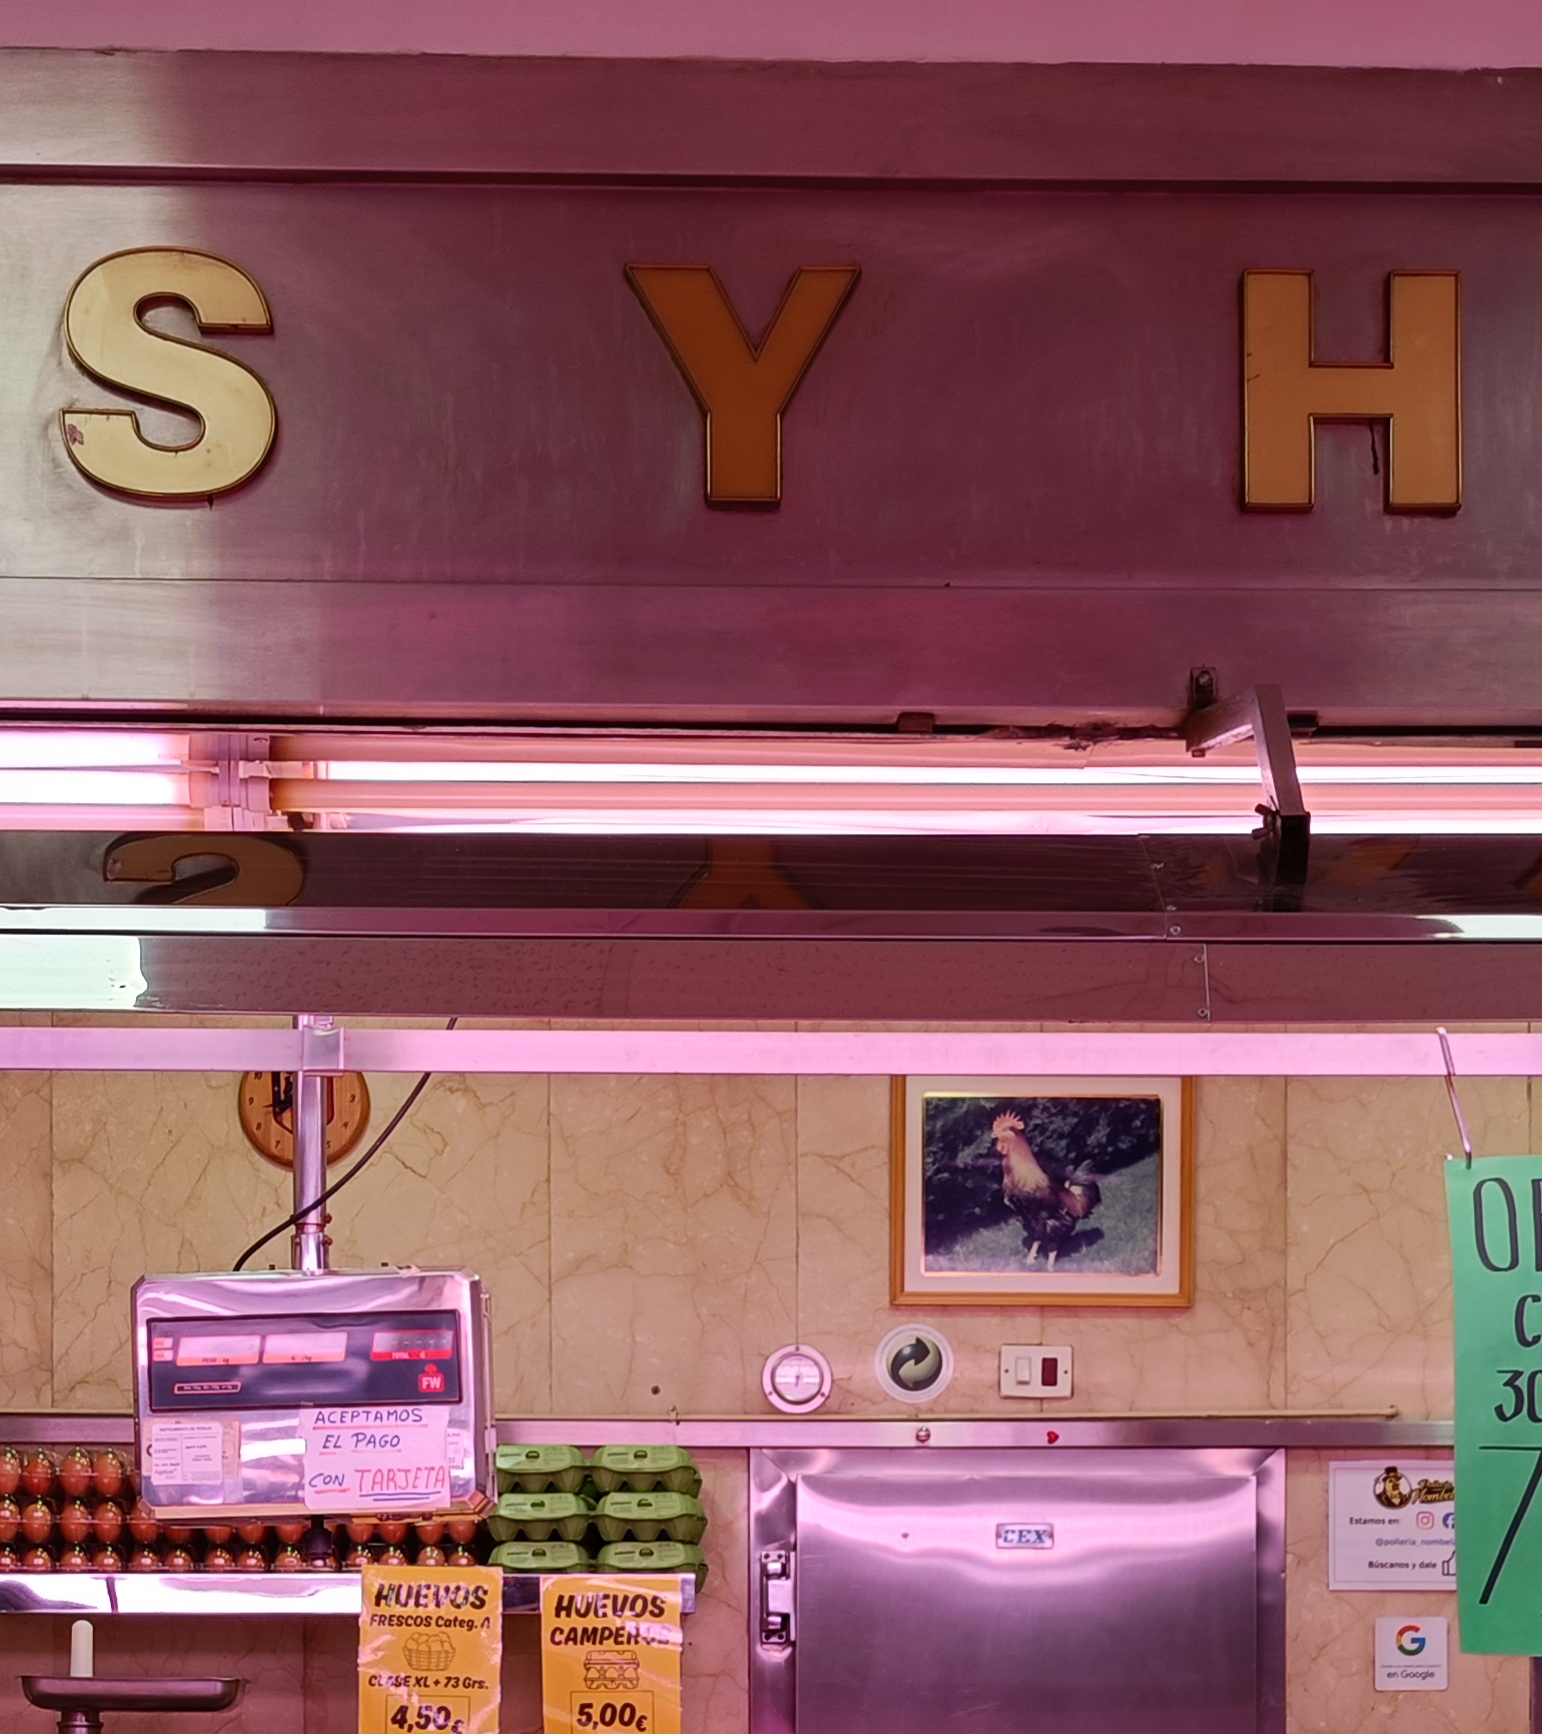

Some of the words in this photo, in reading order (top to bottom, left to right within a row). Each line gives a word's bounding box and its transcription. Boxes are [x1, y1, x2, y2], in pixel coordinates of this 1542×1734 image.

[624, 264, 860, 506] Y
[422, 1376, 442, 1390] FW
[314, 1407, 425, 1425] ACEPTAMOS
[322, 1434, 342, 1449] EL
[351, 1432, 401, 1449] PAGO
[308, 1472, 345, 1488] CON
[354, 1465, 446, 1492] TARJETA
[1349, 1517, 1386, 1525] Estamos
[1368, 1559, 1410, 1569] Búscanos
[1418, 1560, 1437, 1569] dale
[374, 1583, 489, 1610] HUEVOS
[554, 1593, 667, 1619] HUEVOS
[369, 1614, 432, 1629] FRESCOS
[435, 1615, 479, 1632] Categ.
[480, 1617, 491, 1629] A
[550, 1626, 673, 1647] CAMPEROS
[368, 1674, 411, 1688] CLASE
[412, 1676, 431, 1689] XL
[443, 1676, 460, 1689] 73
[462, 1677, 489, 1690] Grs.
[1401, 1669, 1435, 1680] Google
